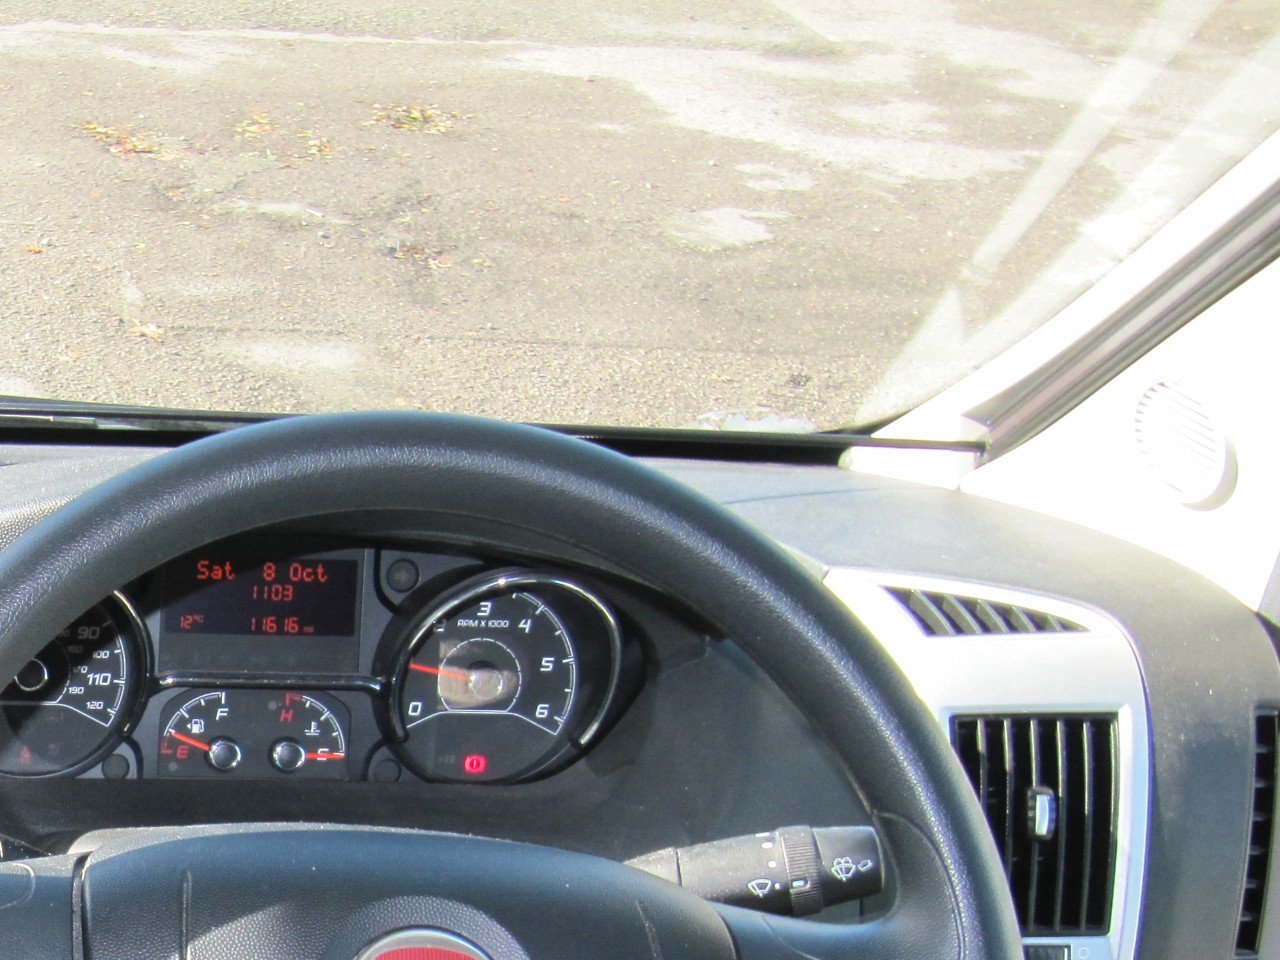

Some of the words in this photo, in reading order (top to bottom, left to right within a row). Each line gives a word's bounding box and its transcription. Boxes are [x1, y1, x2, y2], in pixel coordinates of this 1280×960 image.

[197, 560, 236, 580] Sat
[263, 562, 276, 581] 8
[289, 562, 328, 583] Oct
[477, 602, 492, 616] 3
[457, 620, 479, 628] RPM
[487, 620, 510, 628] 1000
[518, 619, 532, 633] 4
[77, 627, 100, 639] 90
[93, 650, 110, 659] 100
[540, 657, 555, 671] 5
[86, 673, 111, 686] 110
[86, 701, 104, 710] 120
[408, 701, 422, 716] 0
[535, 704, 549, 717] 6
[216, 708, 229, 720] F
[279, 709, 294, 722] H
